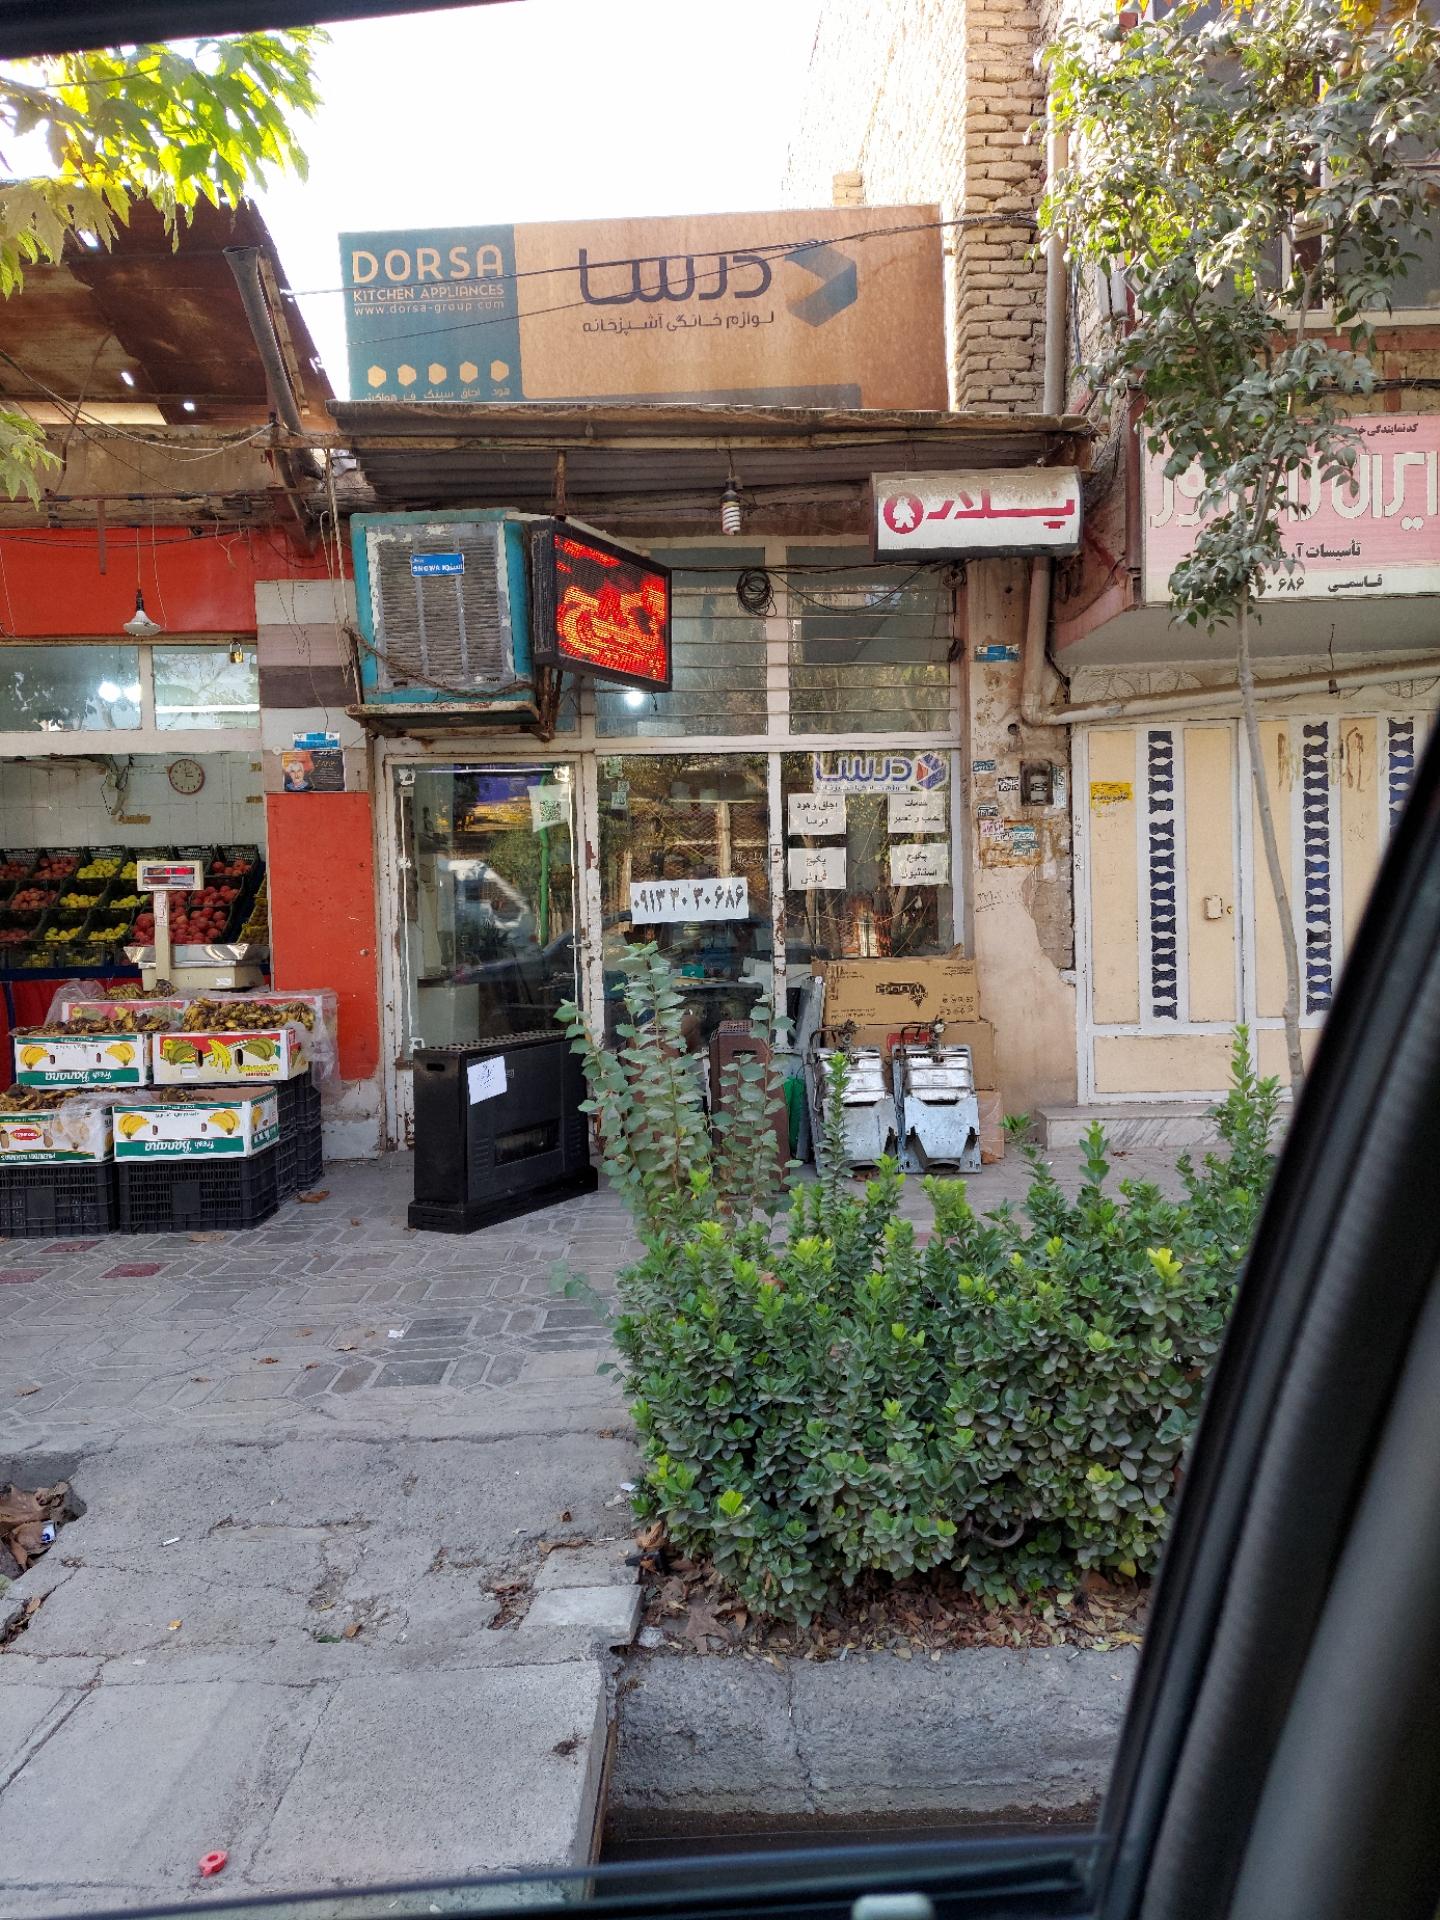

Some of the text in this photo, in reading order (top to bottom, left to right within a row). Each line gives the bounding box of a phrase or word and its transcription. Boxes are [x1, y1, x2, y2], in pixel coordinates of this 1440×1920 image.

[352, 244, 503, 284] DORSA
[578, 247, 772, 305] درسا
[353, 284, 504, 302] KITCHEN APPLIANCES
[582, 311, 775, 336] لوازم خانگی آشپزخانه
[1332, 451, 1439, 530] ایران
[1328, 573, 1383, 593] قاسمی
[815, 752, 913, 782] درسا
[45, 1071, 90, 1082] Banana
[145, 1140, 192, 1153] Banana
